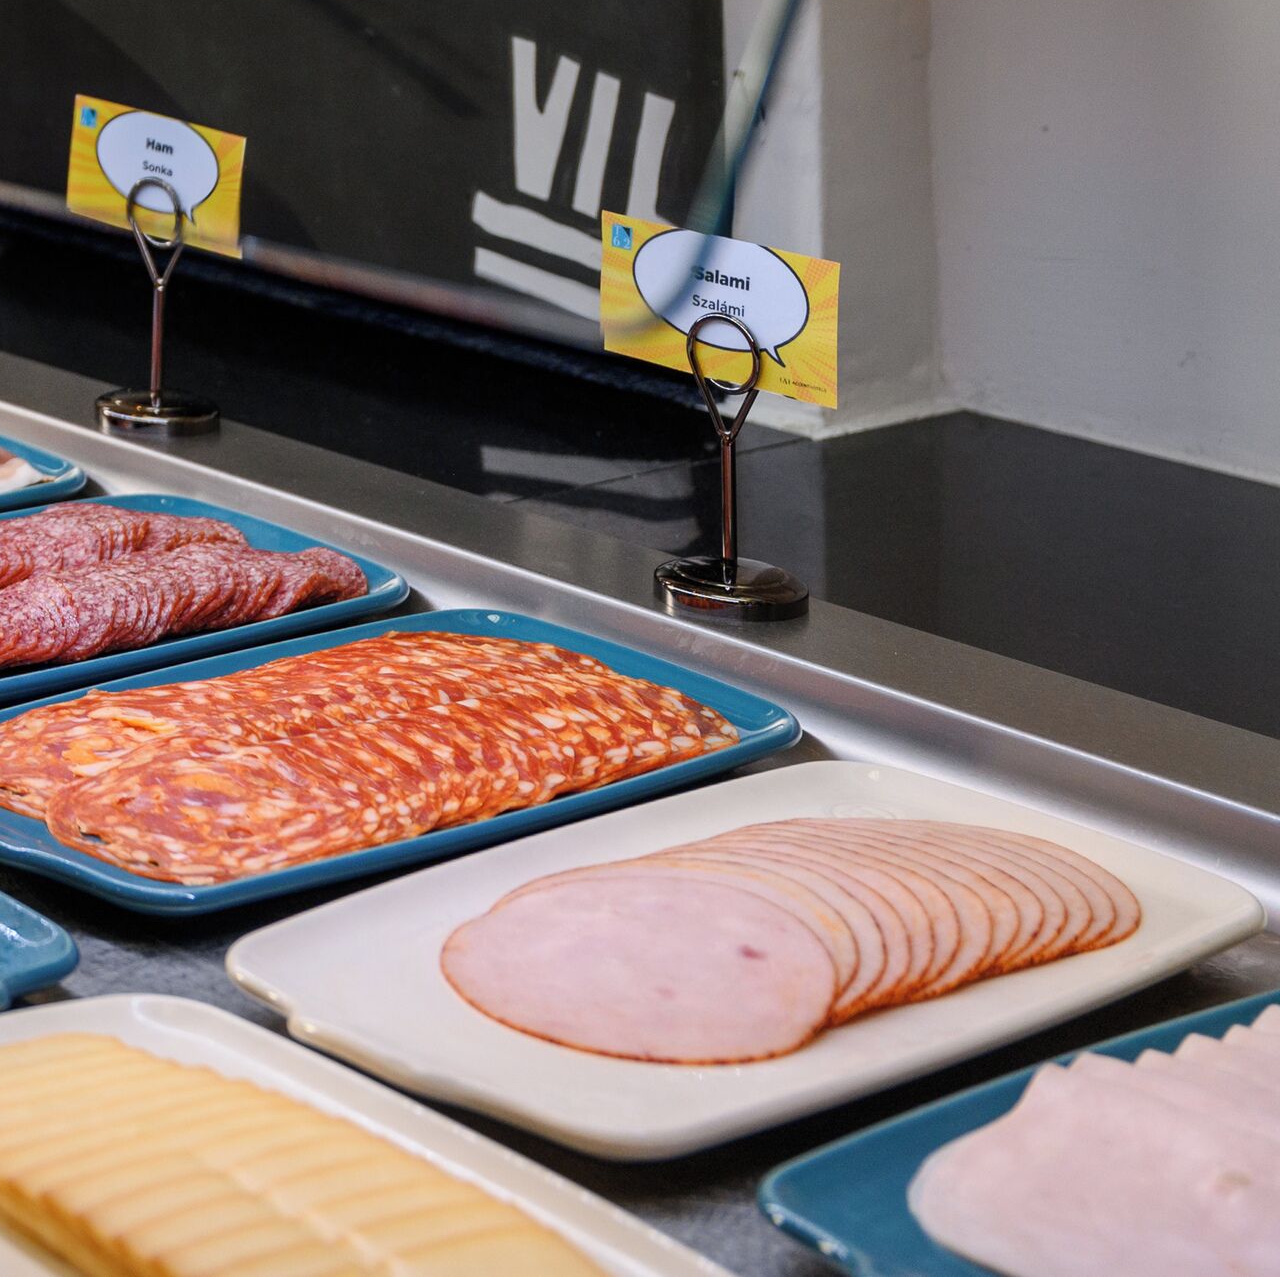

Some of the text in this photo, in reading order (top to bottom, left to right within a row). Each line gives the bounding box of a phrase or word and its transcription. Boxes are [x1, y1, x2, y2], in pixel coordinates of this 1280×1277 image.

[145, 137, 174, 155] Ham
[142, 160, 174, 177] Sonka
[692, 264, 751, 291] Salami
[691, 293, 746, 318] Szalámi
